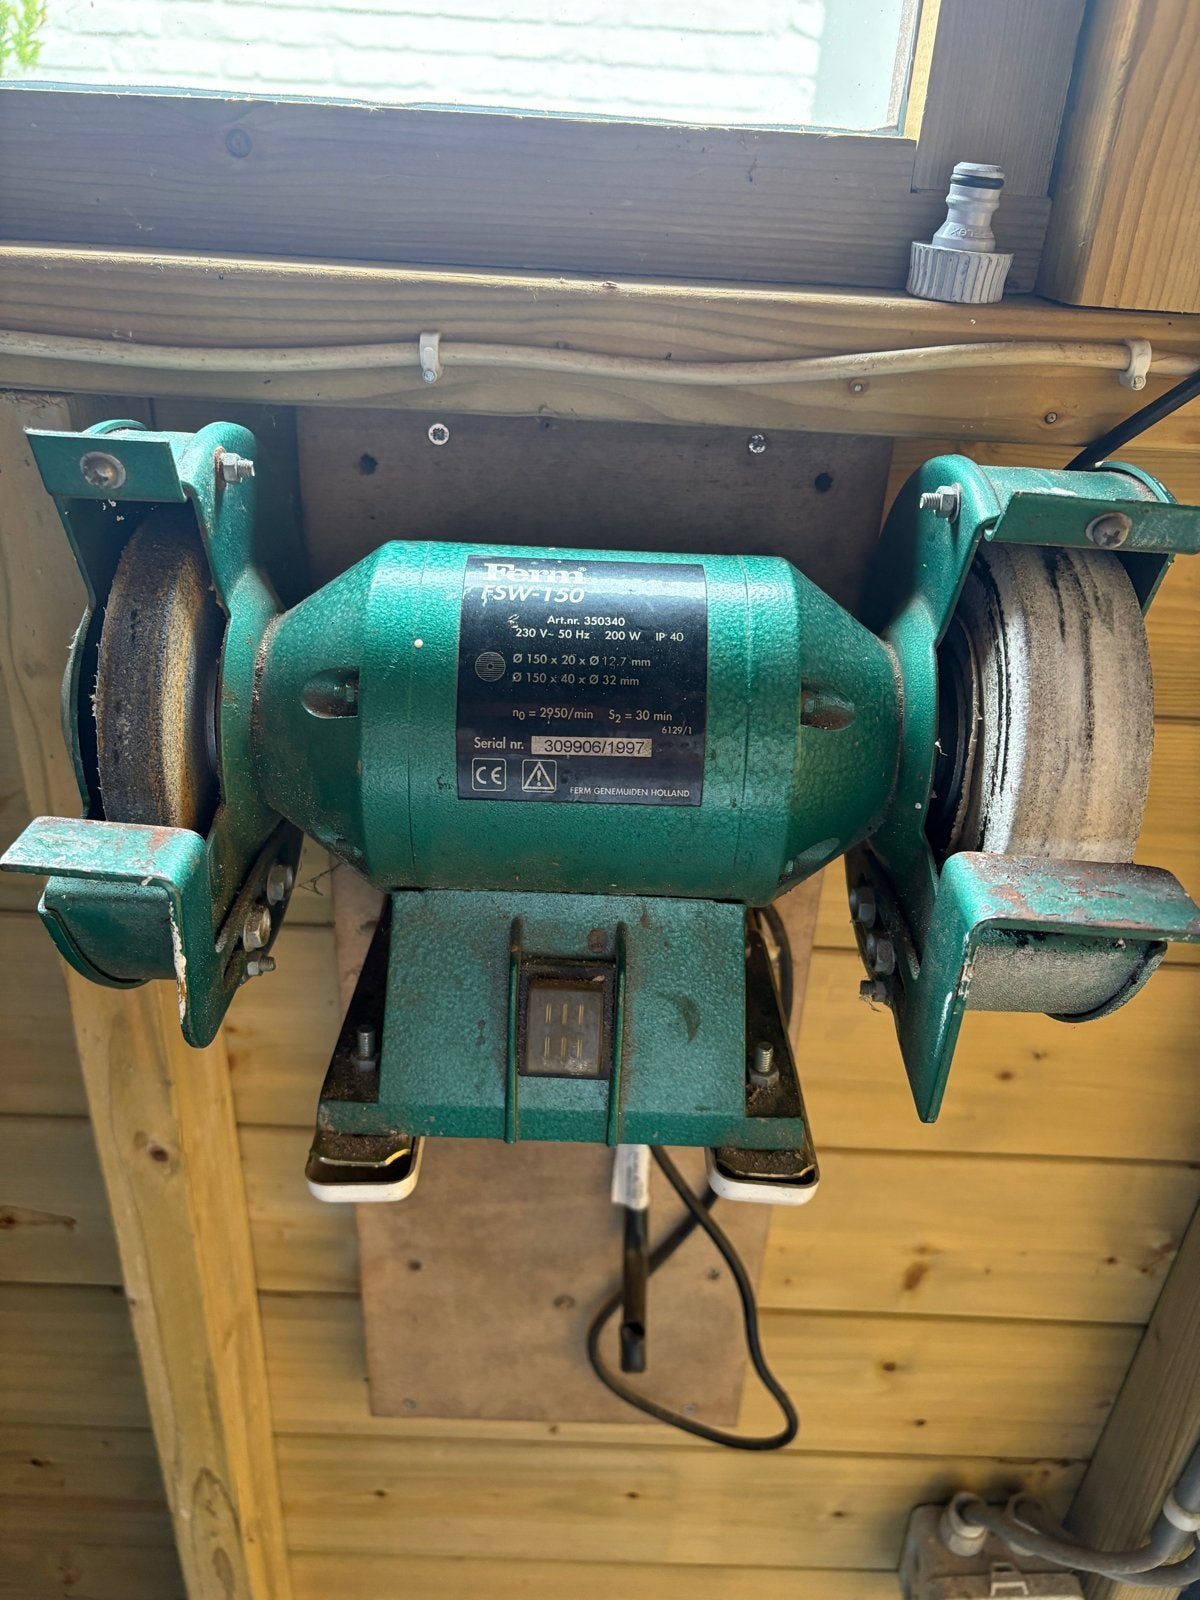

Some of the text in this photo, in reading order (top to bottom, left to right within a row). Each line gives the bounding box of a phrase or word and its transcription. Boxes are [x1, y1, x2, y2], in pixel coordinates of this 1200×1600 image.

[482, 562, 586, 585] Ferm
[546, 615, 626, 627] Art.nr. 350340
[515, 627, 537, 638] 230
[558, 629, 573, 639] 50
[575, 630, 591, 640] Hz
[604, 630, 626, 641] 200
[628, 631, 642, 641] W
[655, 632, 666, 642] IP
[669, 632, 685, 642] 40
[527, 653, 548, 664] 150
[561, 654, 576, 665] 20
[601, 656, 627, 667] 12.7
[631, 659, 651, 667] mm
[526, 672, 547, 683] 150
[560, 673, 575, 684] 40
[602, 674, 617, 685] 32
[620, 677, 640, 686] mm
[540, 708, 594, 720] 2950/min
[636, 710, 650, 721] 30
[653, 711, 673, 721] min
[661, 726, 692, 735] 6129/1
[474, 737, 645, 755] Serial nr. 309906/1997
[570, 787, 690, 797] FERM GENEMUIDEN HOLLAND
